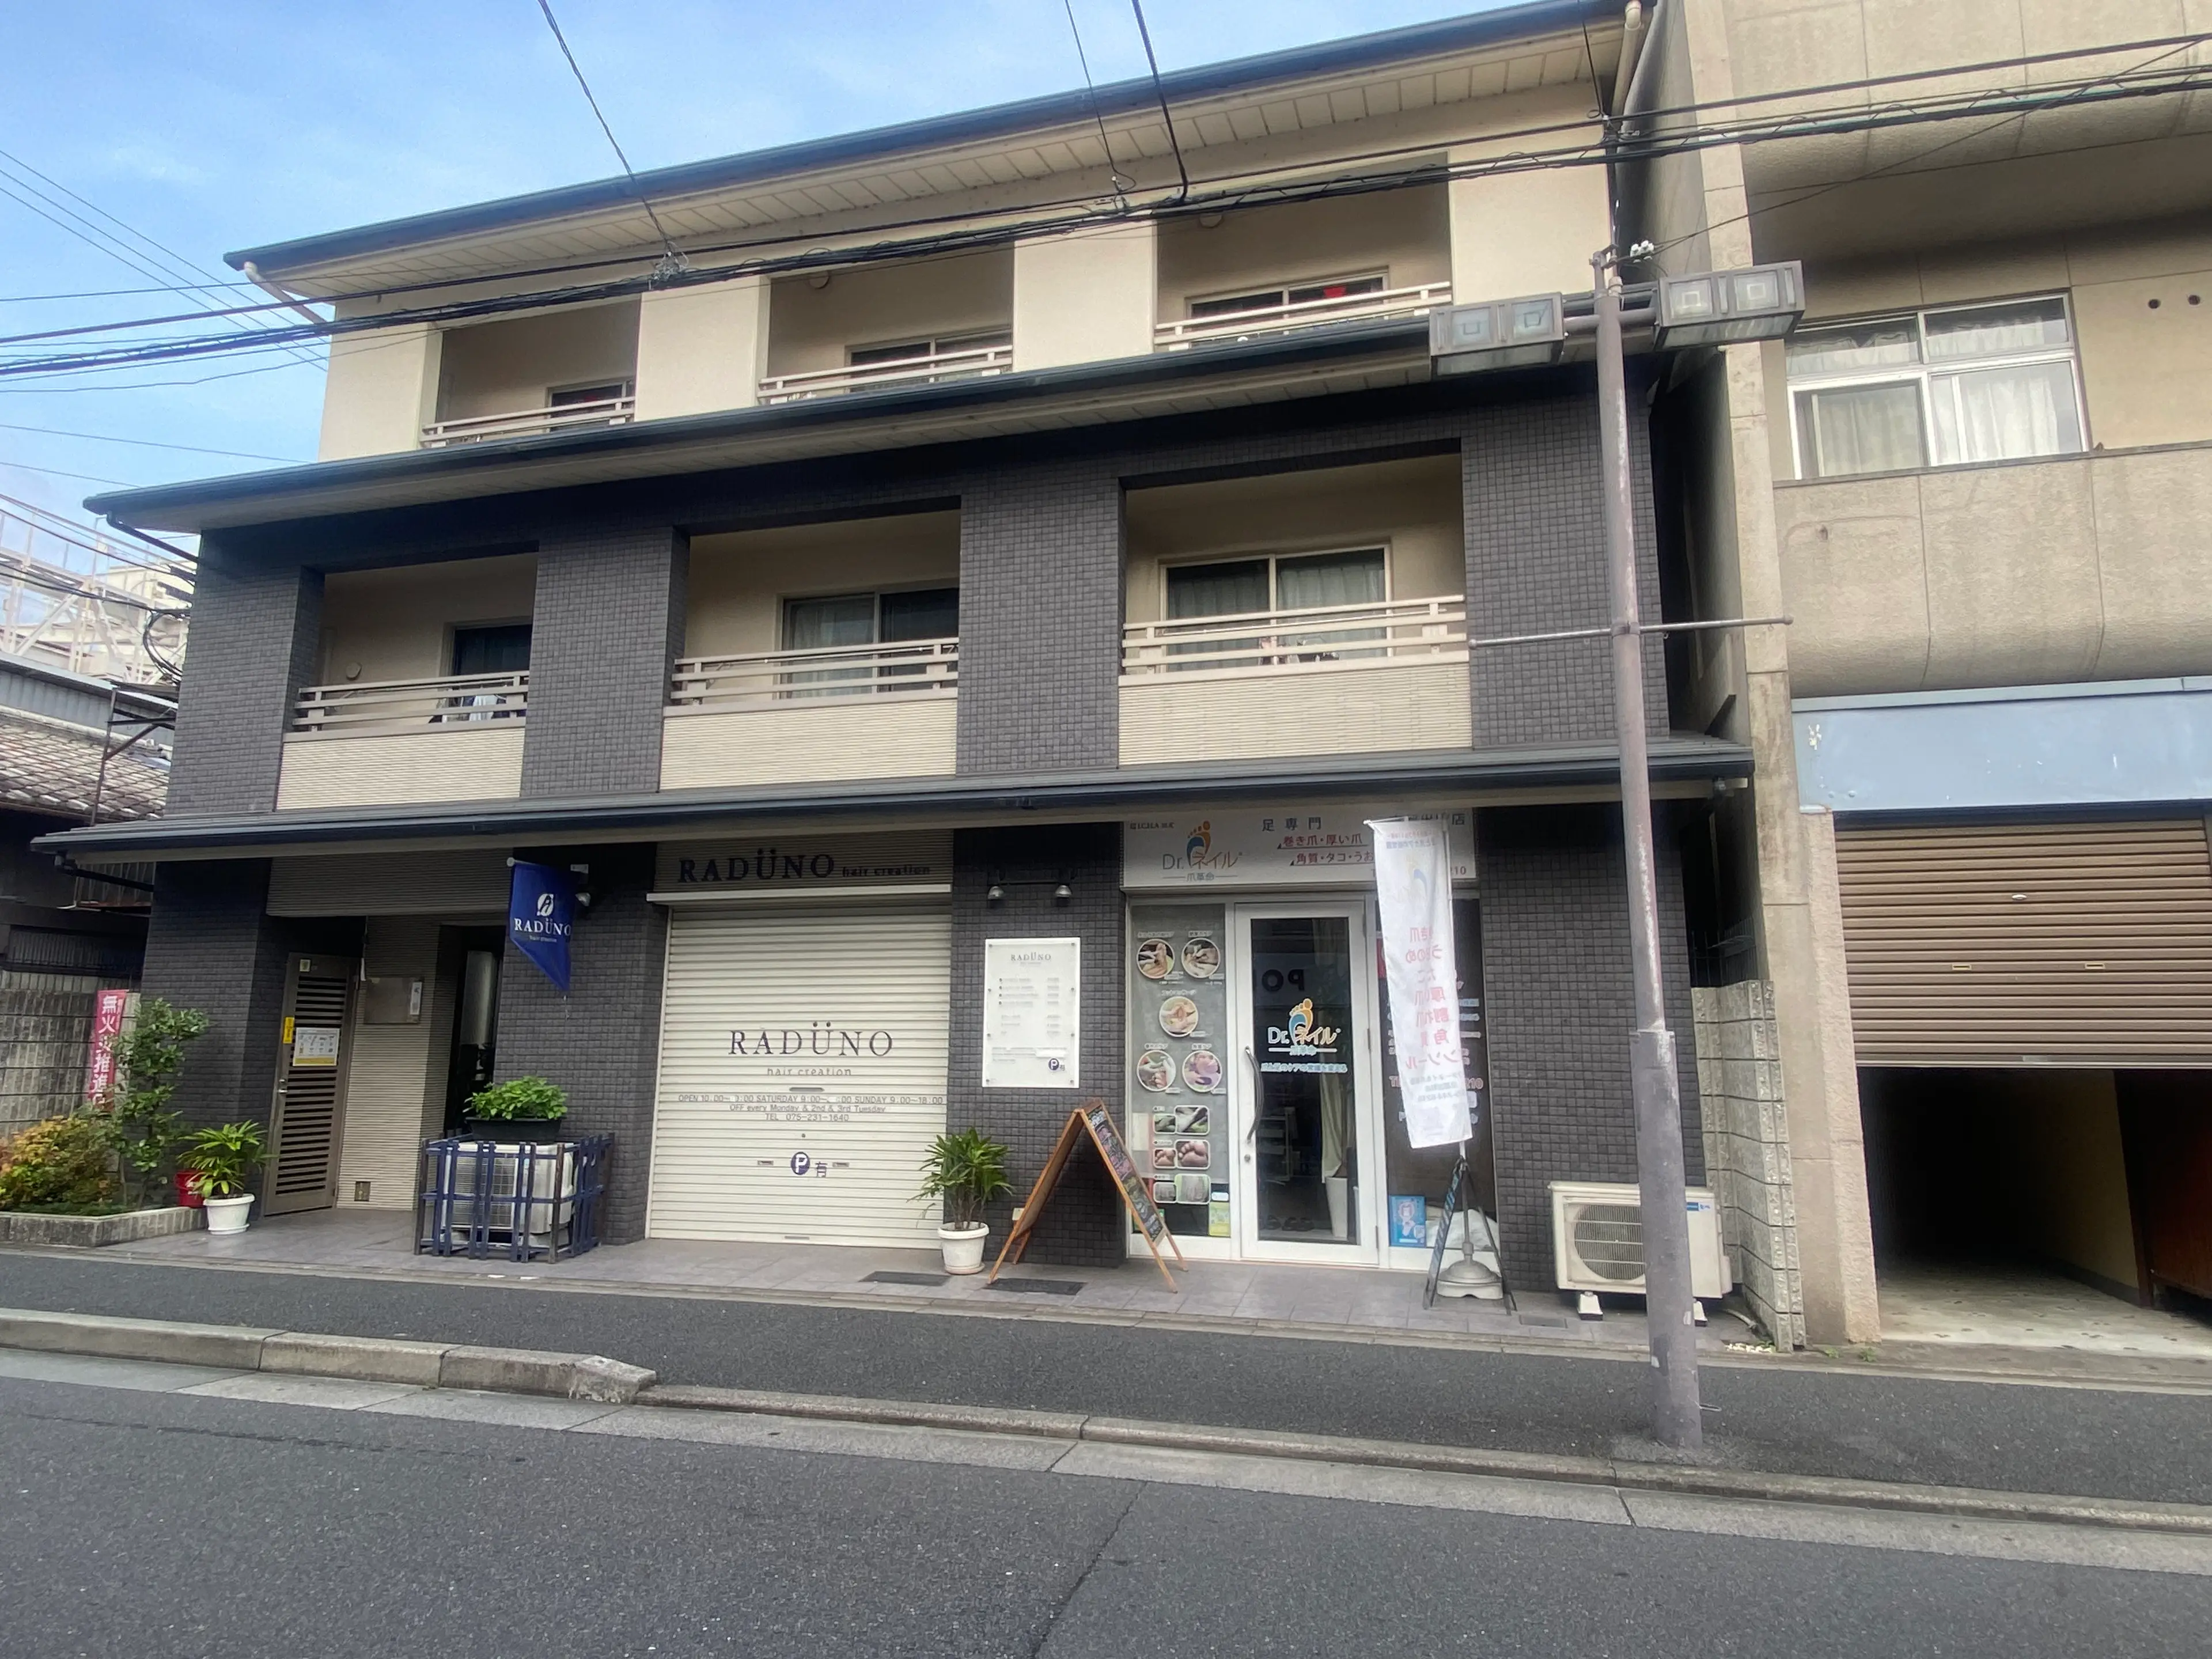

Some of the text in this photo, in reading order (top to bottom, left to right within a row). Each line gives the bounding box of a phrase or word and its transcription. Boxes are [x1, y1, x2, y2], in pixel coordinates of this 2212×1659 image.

[677, 848, 834, 882] RADÜNO
[842, 866, 869, 877] hair
[514, 918, 571, 937] RADÜNO
[1011, 952, 1051, 961] RADÜNO
[728, 1021, 893, 1056] RADÜNO
[767, 1066, 851, 1077] hair creation
[756, 1094, 797, 1103] SATURDAY
[855, 1096, 887, 1104] SUNDAY
[770, 1104, 799, 1112] Monday
[854, 1105, 886, 1113] Tuesday
